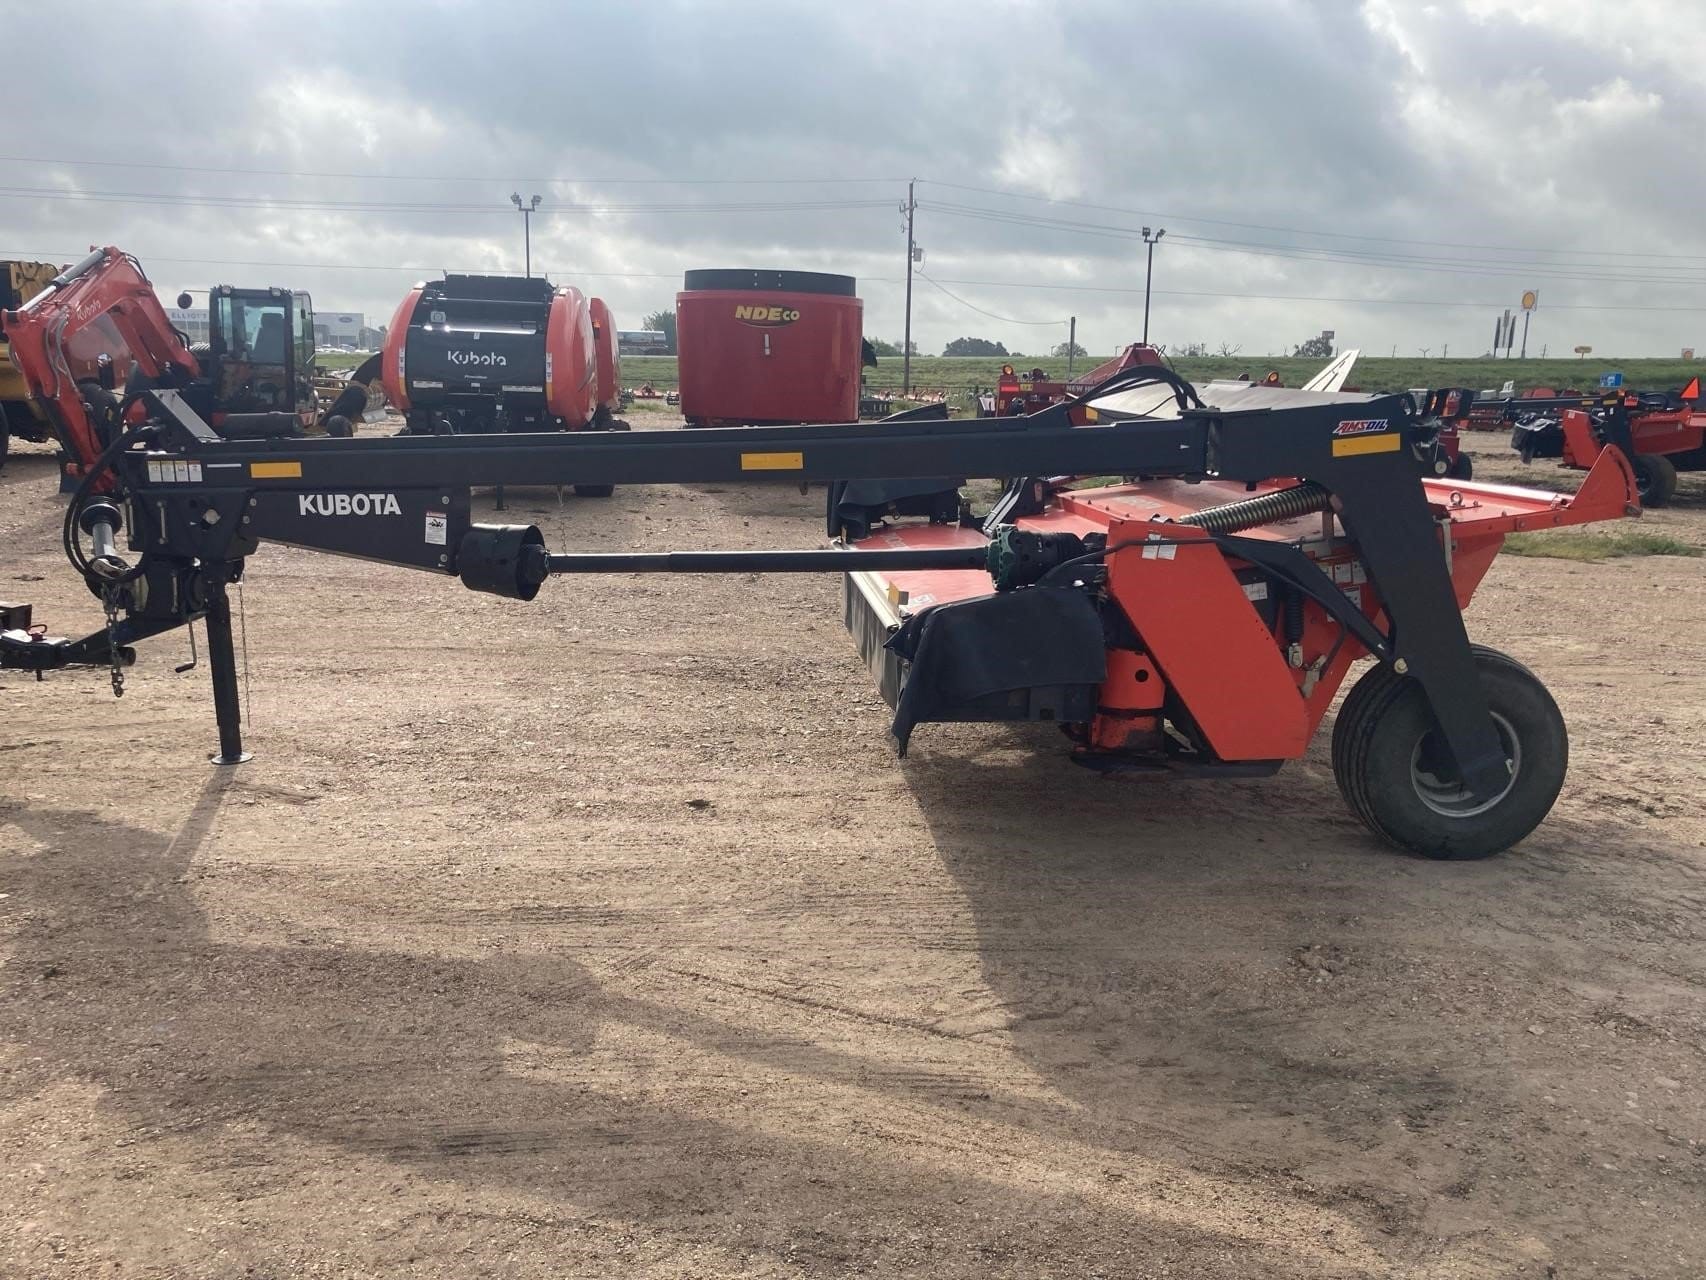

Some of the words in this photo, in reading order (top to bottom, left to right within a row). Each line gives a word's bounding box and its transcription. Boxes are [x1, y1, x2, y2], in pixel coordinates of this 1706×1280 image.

[447, 350, 507, 366] Kubota
[1333, 419, 1388, 435] AMSOIL
[299, 493, 402, 516] KUBOTA
